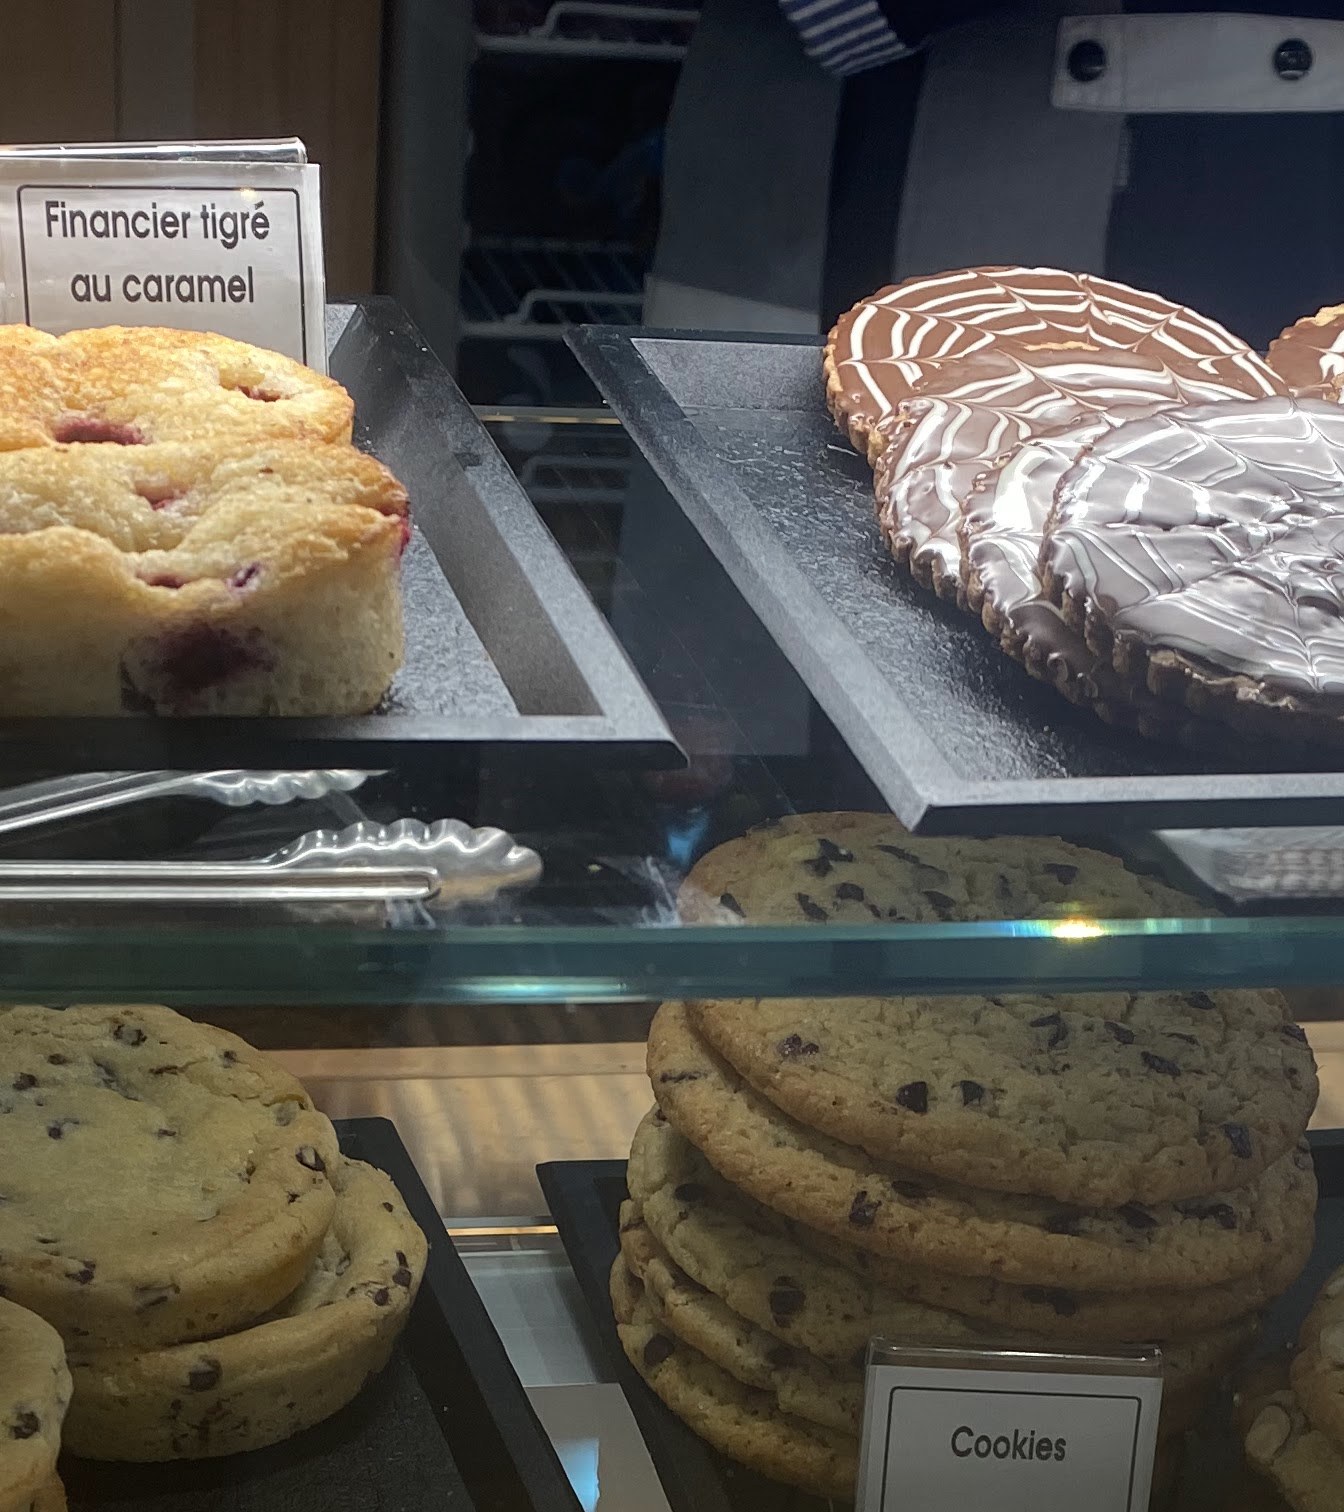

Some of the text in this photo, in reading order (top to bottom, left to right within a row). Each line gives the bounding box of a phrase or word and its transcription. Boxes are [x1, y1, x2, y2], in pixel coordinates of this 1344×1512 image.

[45, 200, 270, 249] Financier tigré
[71, 265, 254, 303] au caramel
[950, 1425, 1066, 1462] Cookies
